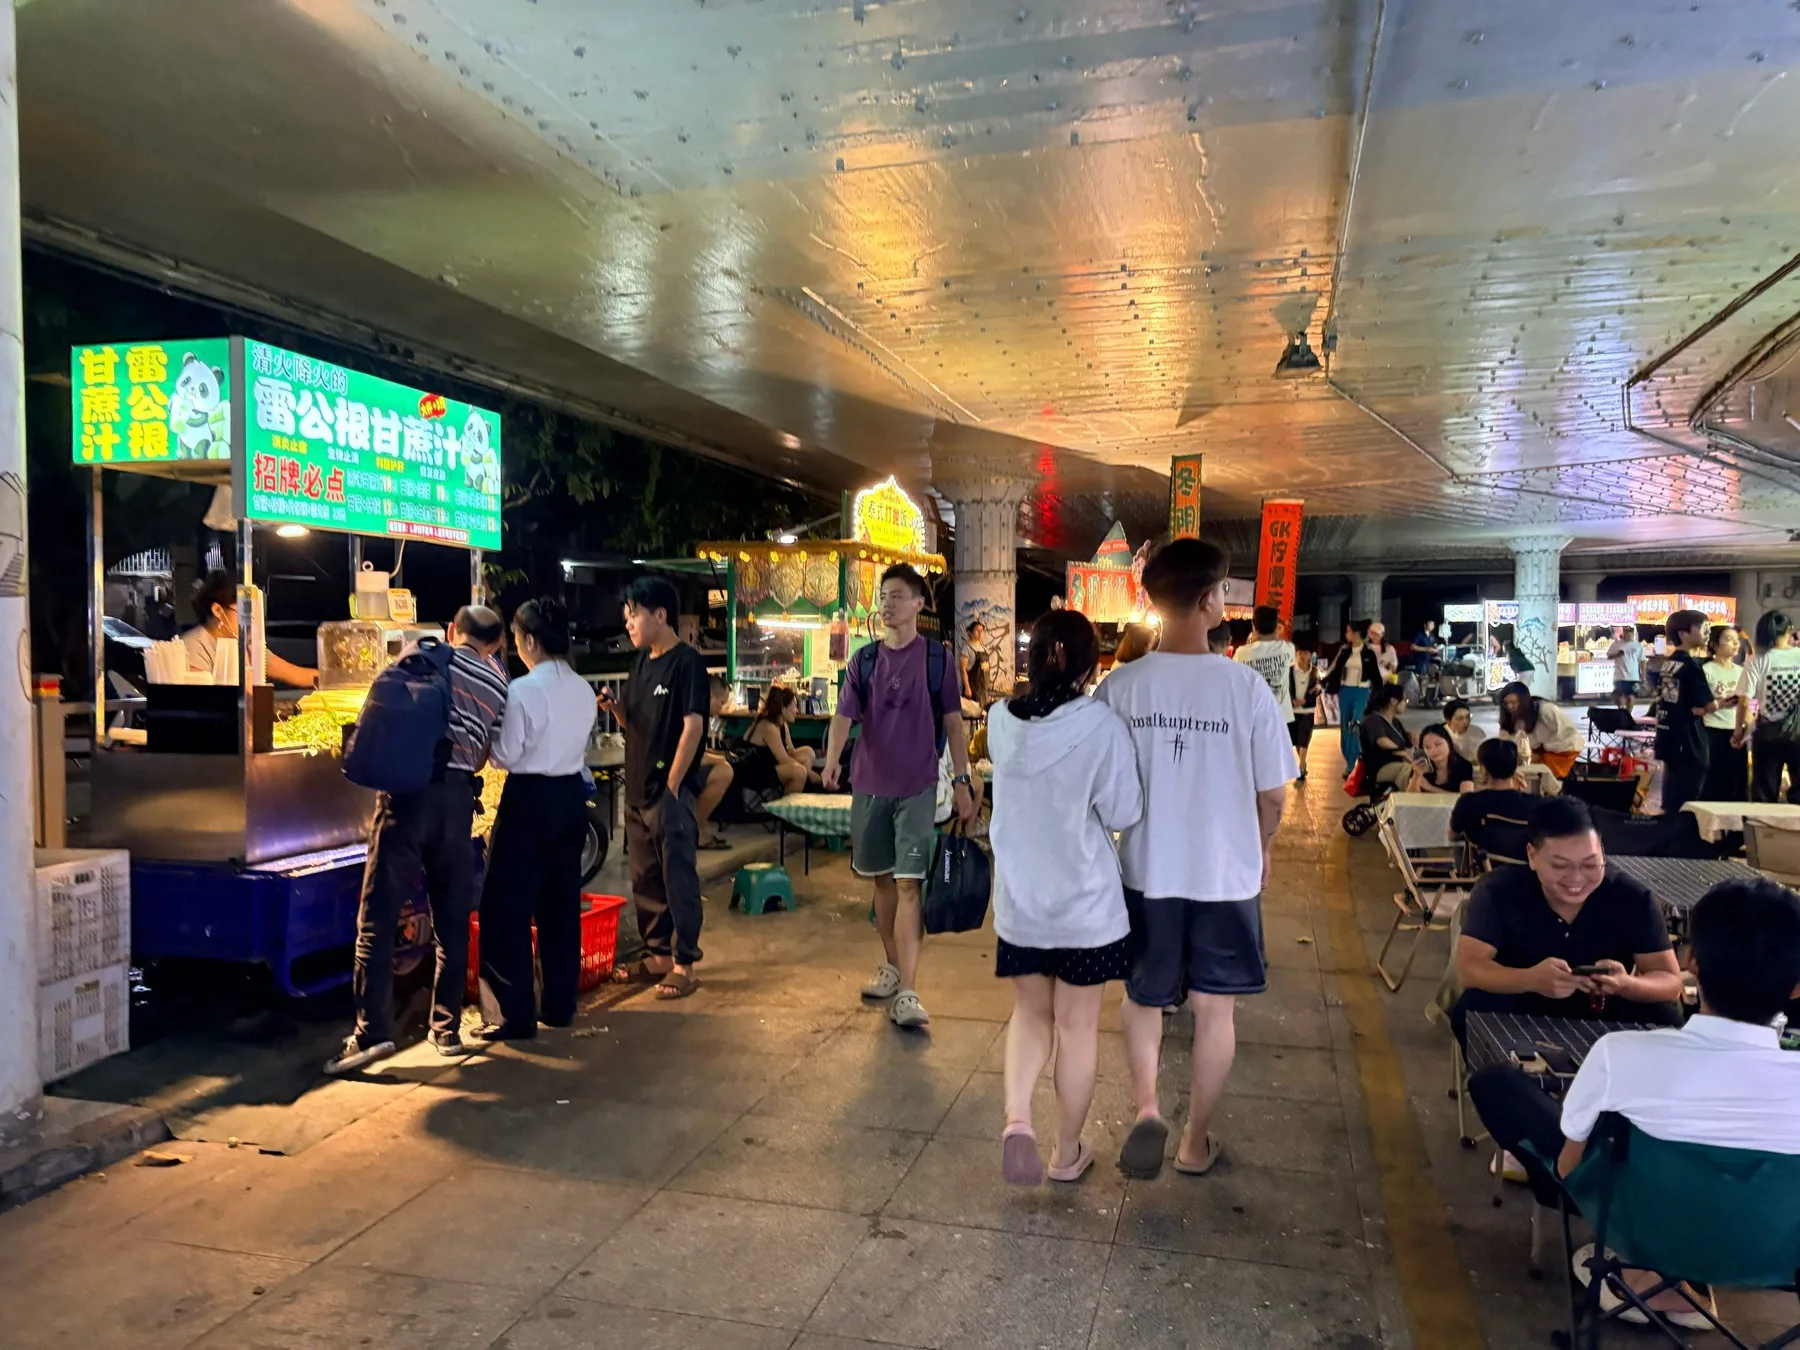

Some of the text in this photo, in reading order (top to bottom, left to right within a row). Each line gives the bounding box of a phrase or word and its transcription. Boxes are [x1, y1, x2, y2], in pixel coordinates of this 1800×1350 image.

[79, 345, 121, 460] 甘蔗汁
[126, 345, 169, 459] 雷公根
[251, 344, 348, 395] 清火降火的
[253, 376, 461, 470] 雷公根甘蔗汁
[253, 449, 346, 503] 招牌必点
[1130, 712, 1229, 735] walkuptrend
